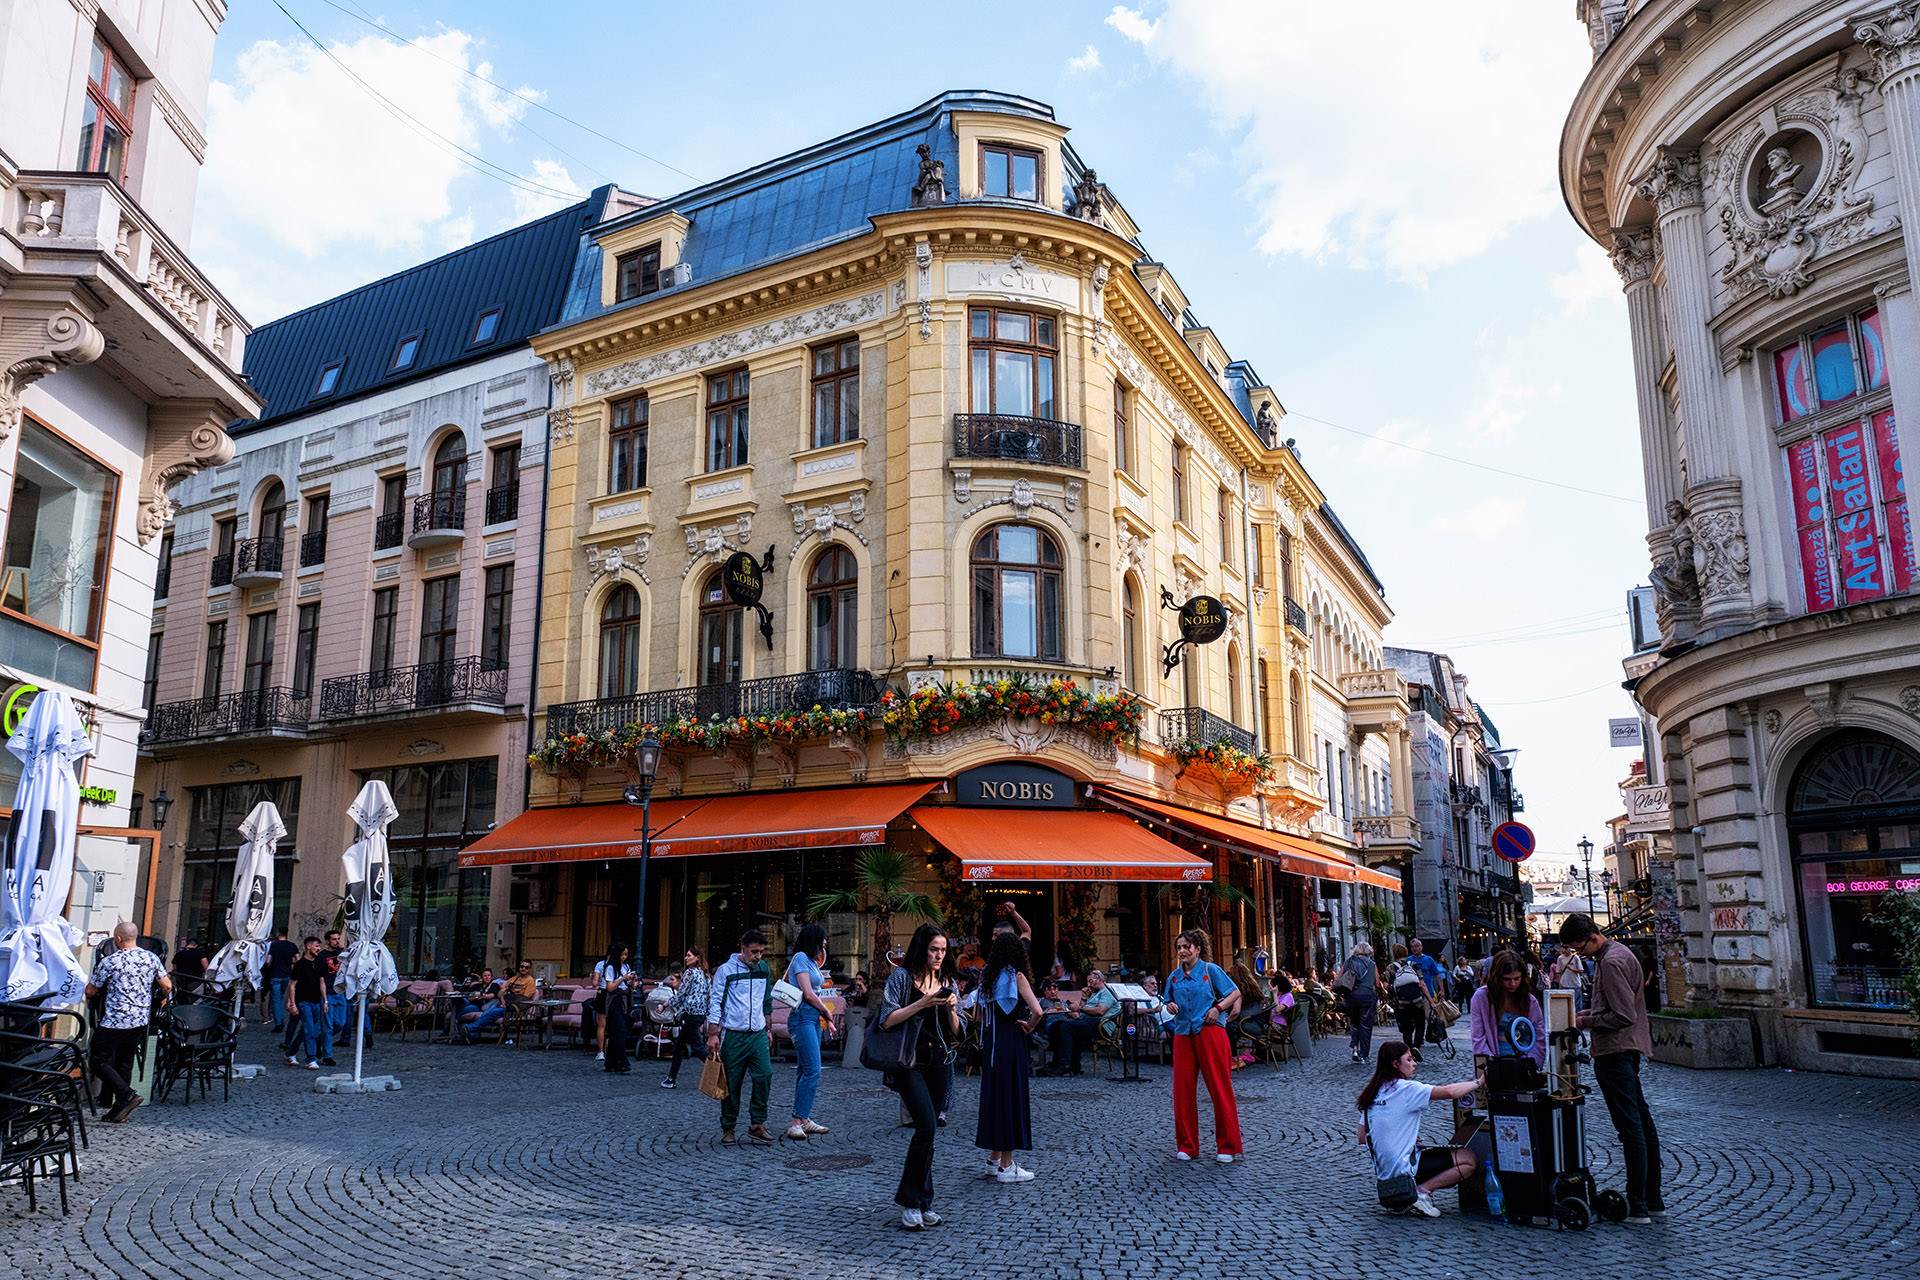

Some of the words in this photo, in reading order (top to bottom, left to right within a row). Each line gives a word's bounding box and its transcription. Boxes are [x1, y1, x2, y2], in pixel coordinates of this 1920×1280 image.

[1798, 444, 1816, 482] visit
[1828, 430, 1870, 534] Safari
[1808, 528, 1832, 605] vizitează
[1845, 533, 1880, 591] Art
[732, 571, 760, 589] NOBIS
[1184, 615, 1221, 626] NOBIS
[980, 781, 1054, 800] NOBIS
[750, 838, 778, 848] NOBIS
[969, 866, 994, 876] APEROL
[1074, 867, 1112, 877] NOBIS
[1826, 883, 1847, 893] BOB
[1850, 880, 1889, 891] GEORGE
[59, 969, 75, 999] AQUA
